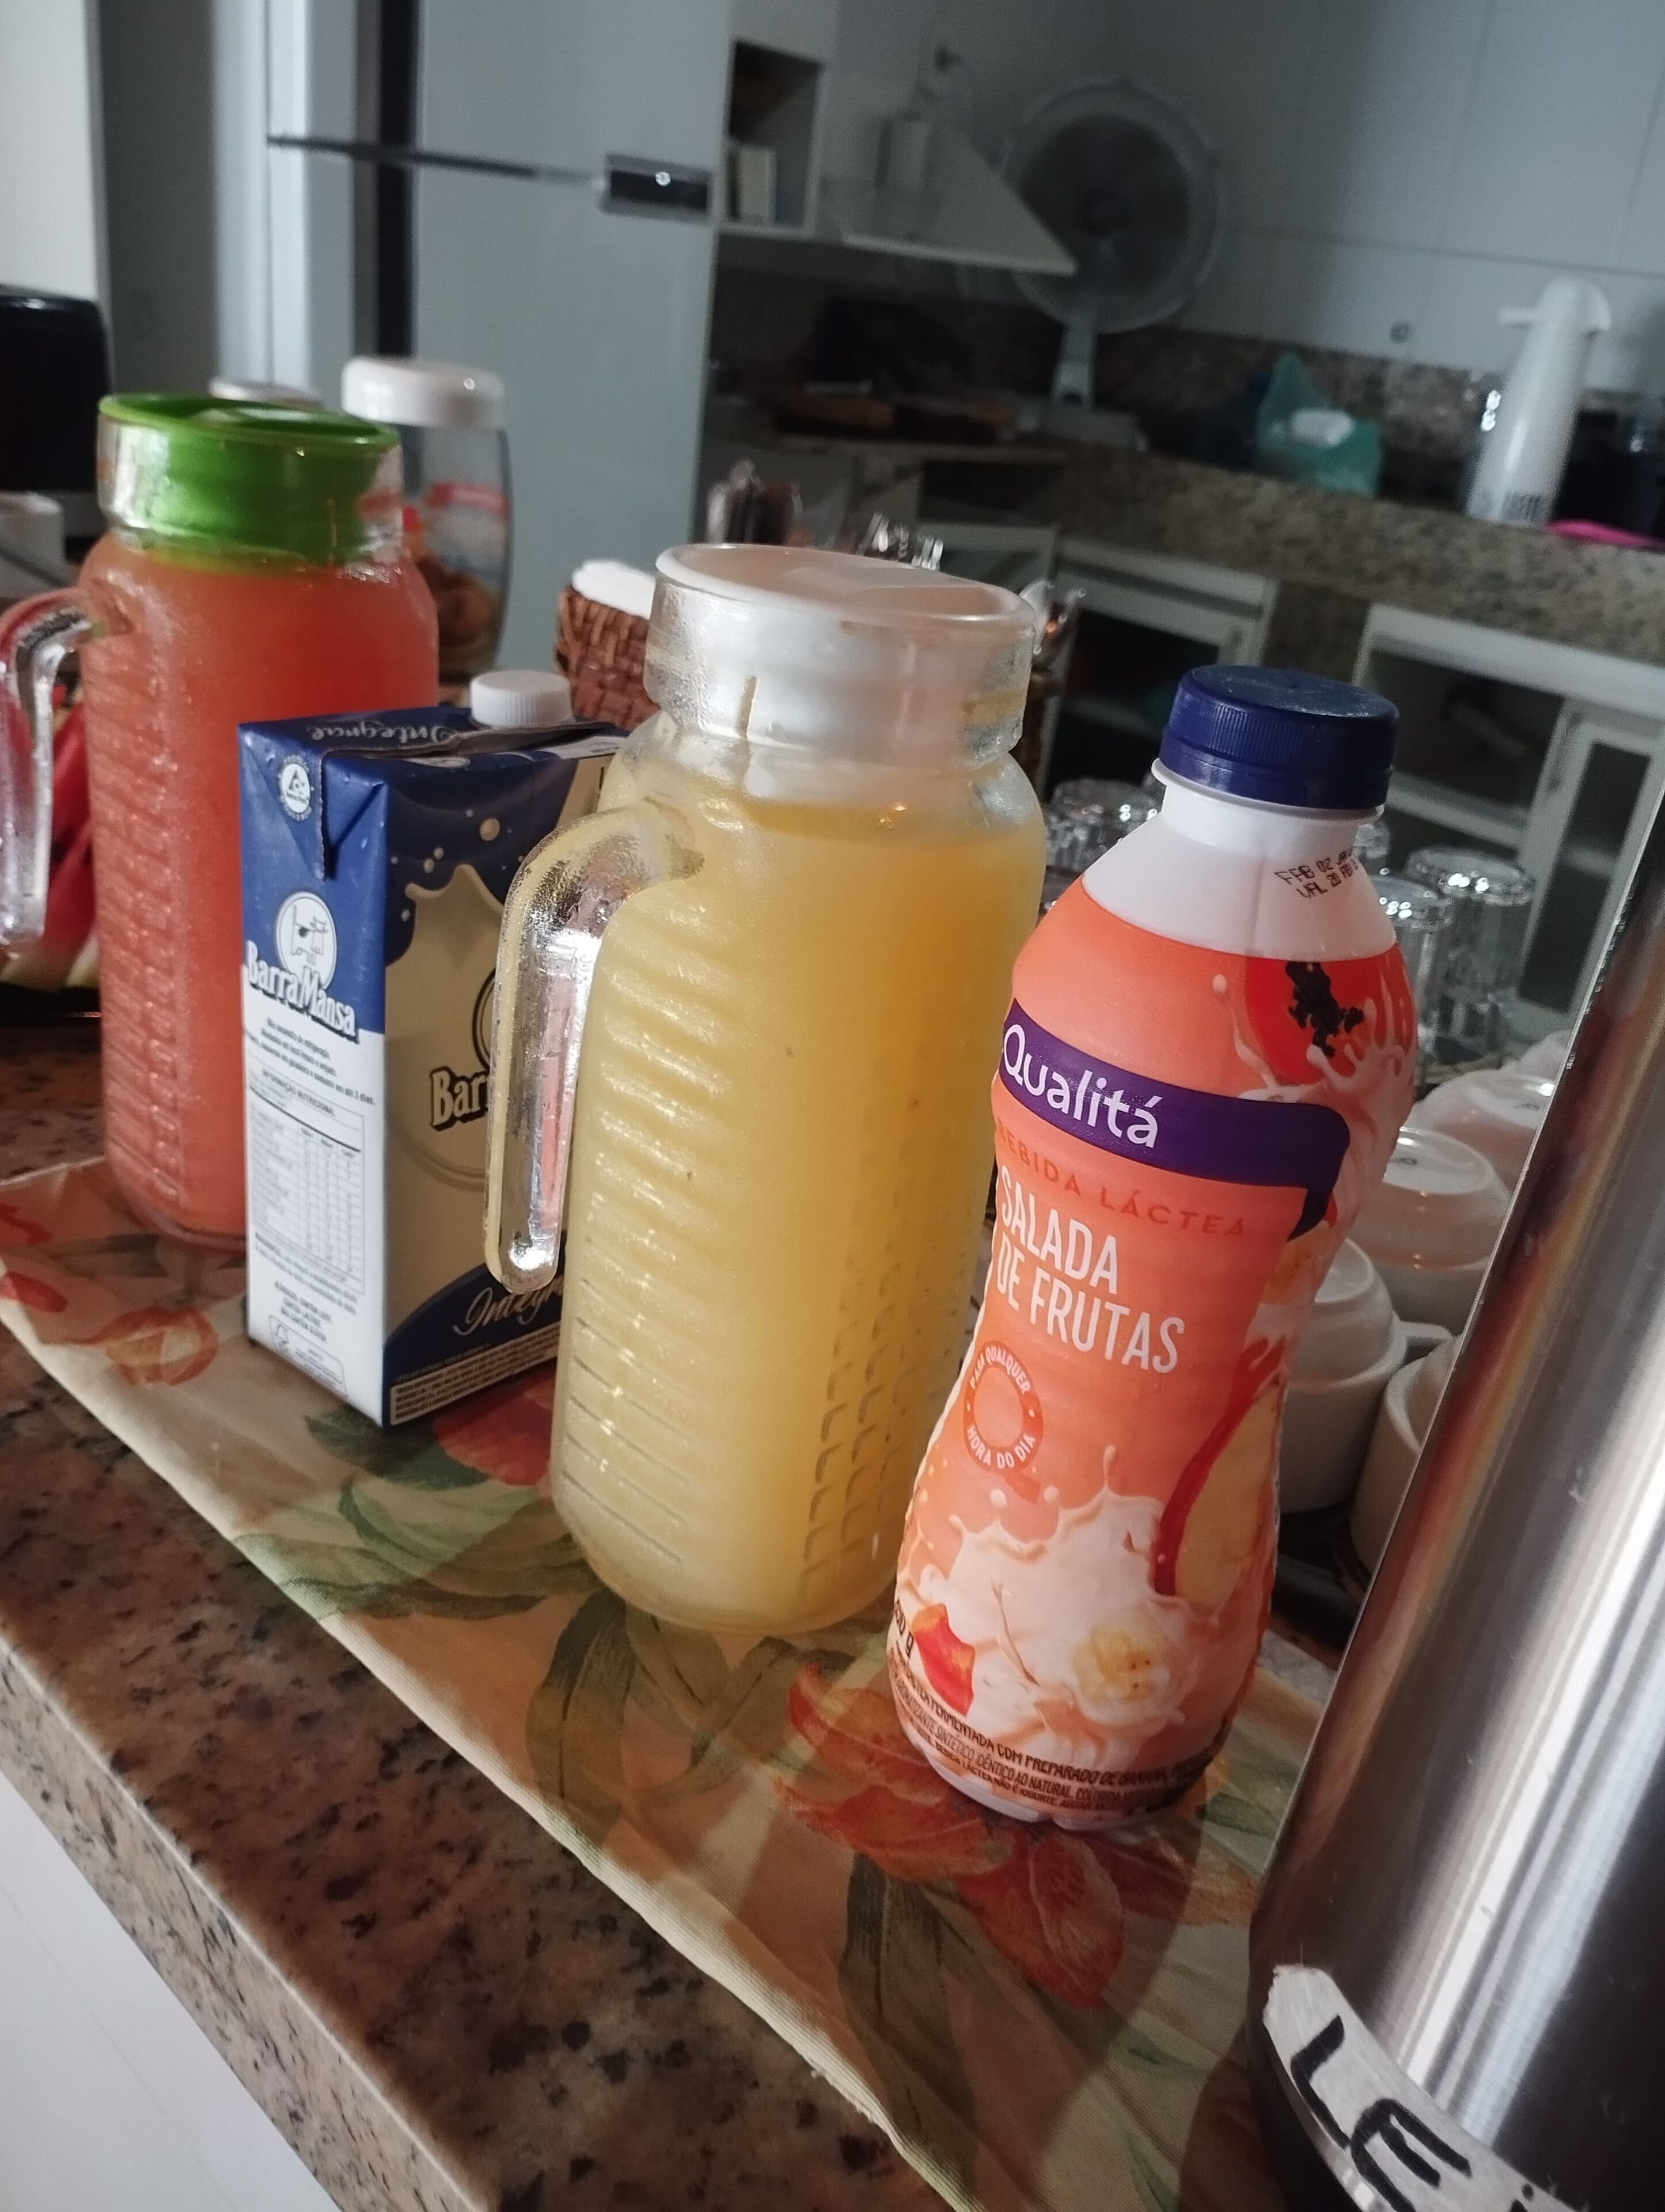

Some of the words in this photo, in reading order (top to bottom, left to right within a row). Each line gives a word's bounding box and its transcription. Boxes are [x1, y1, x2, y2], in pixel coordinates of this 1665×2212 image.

[430, 1066, 488, 1131] Bar
[1004, 1022, 1163, 1149] Qualitá
[1001, 1164, 1119, 1296] SALADA
[1099, 1187, 1246, 1238] LÁCTEA
[996, 1230, 1027, 1311] DE
[1030, 1266, 1186, 1375] FRUTAS
[985, 1346, 1031, 1395] QUALQUER
[968, 1425, 991, 1467] HORA
[996, 1451, 1015, 1469] DO
[1014, 1433, 1036, 1463] DIA
[997, 1742, 1022, 1764] COM
[1025, 1754, 1099, 1785] PREPARADO
[1289, 2014, 1535, 2212] LE
